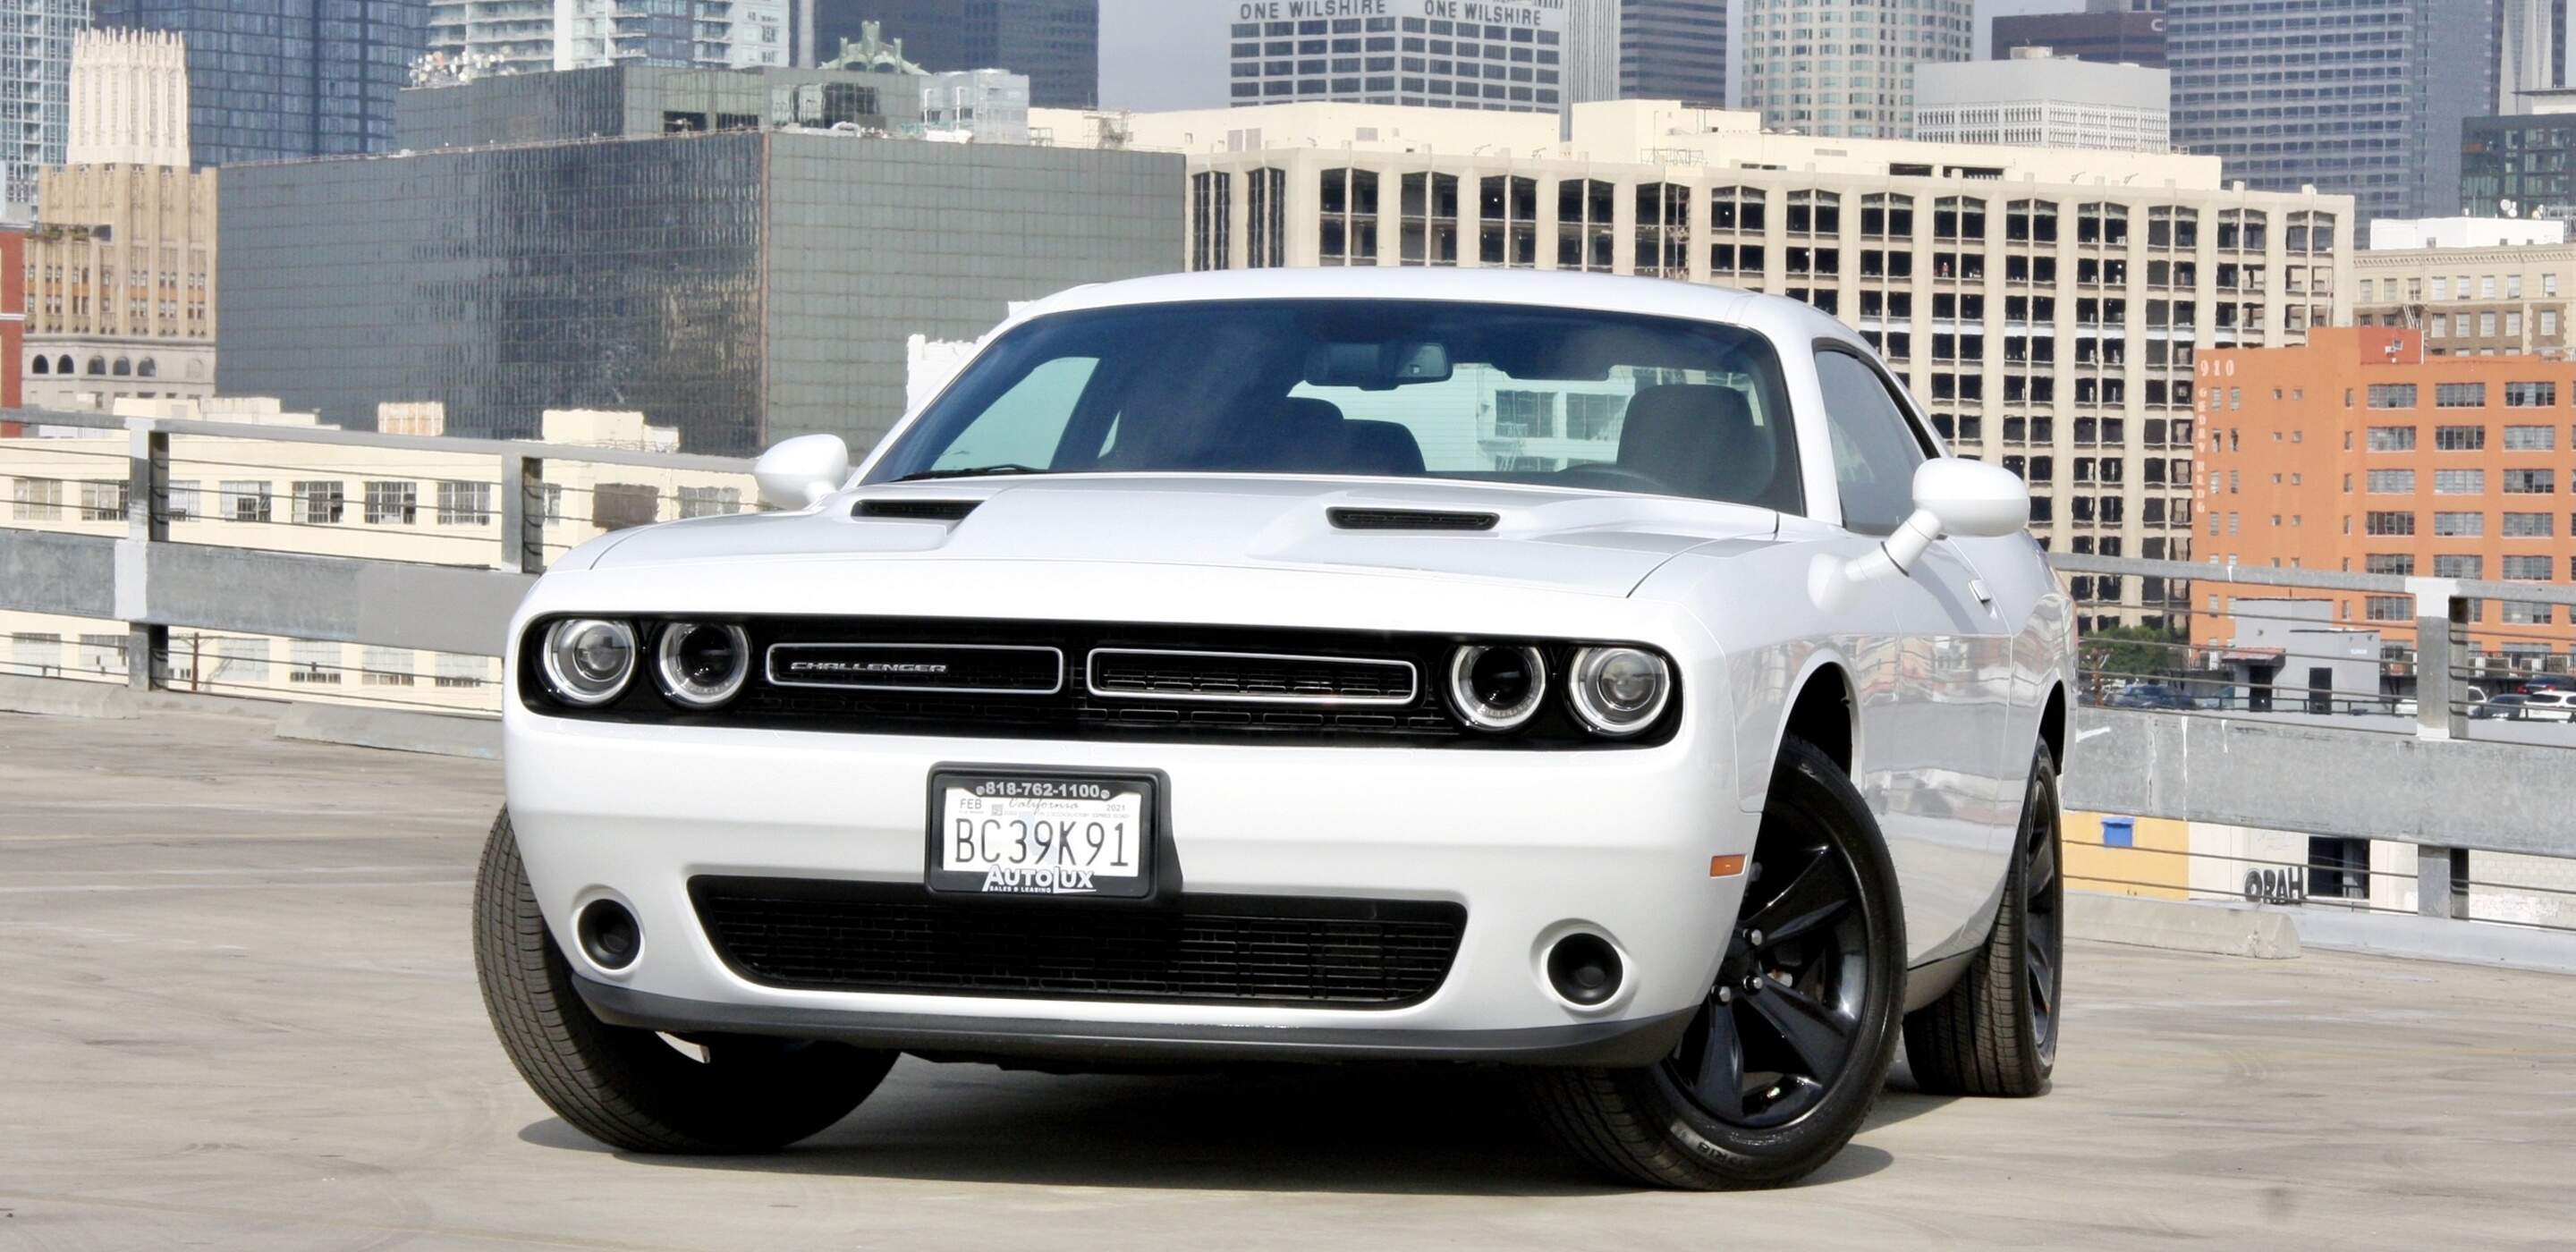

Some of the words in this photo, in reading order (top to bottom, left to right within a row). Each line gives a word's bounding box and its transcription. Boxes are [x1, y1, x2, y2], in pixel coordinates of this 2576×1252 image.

[1240, 3, 1280, 20] ONE
[1289, 0, 1386, 18] WILSHIRE
[1424, 0, 1457, 19] ONE
[1464, 3, 1542, 26] WILSHIRE
[2199, 359, 2235, 376] 910
[791, 662, 947, 672] CHALLENGER
[986, 781, 1100, 798] 818-762-1100
[959, 798, 983, 810] FEB
[1008, 797, 1080, 816] California
[1106, 803, 1127, 813] 2021
[954, 817, 1130, 867] BC39K91
[982, 865, 1097, 894] AUTOLUX
[989, 884, 1012, 892] SALES
[1021, 885, 1052, 893] LEASING
